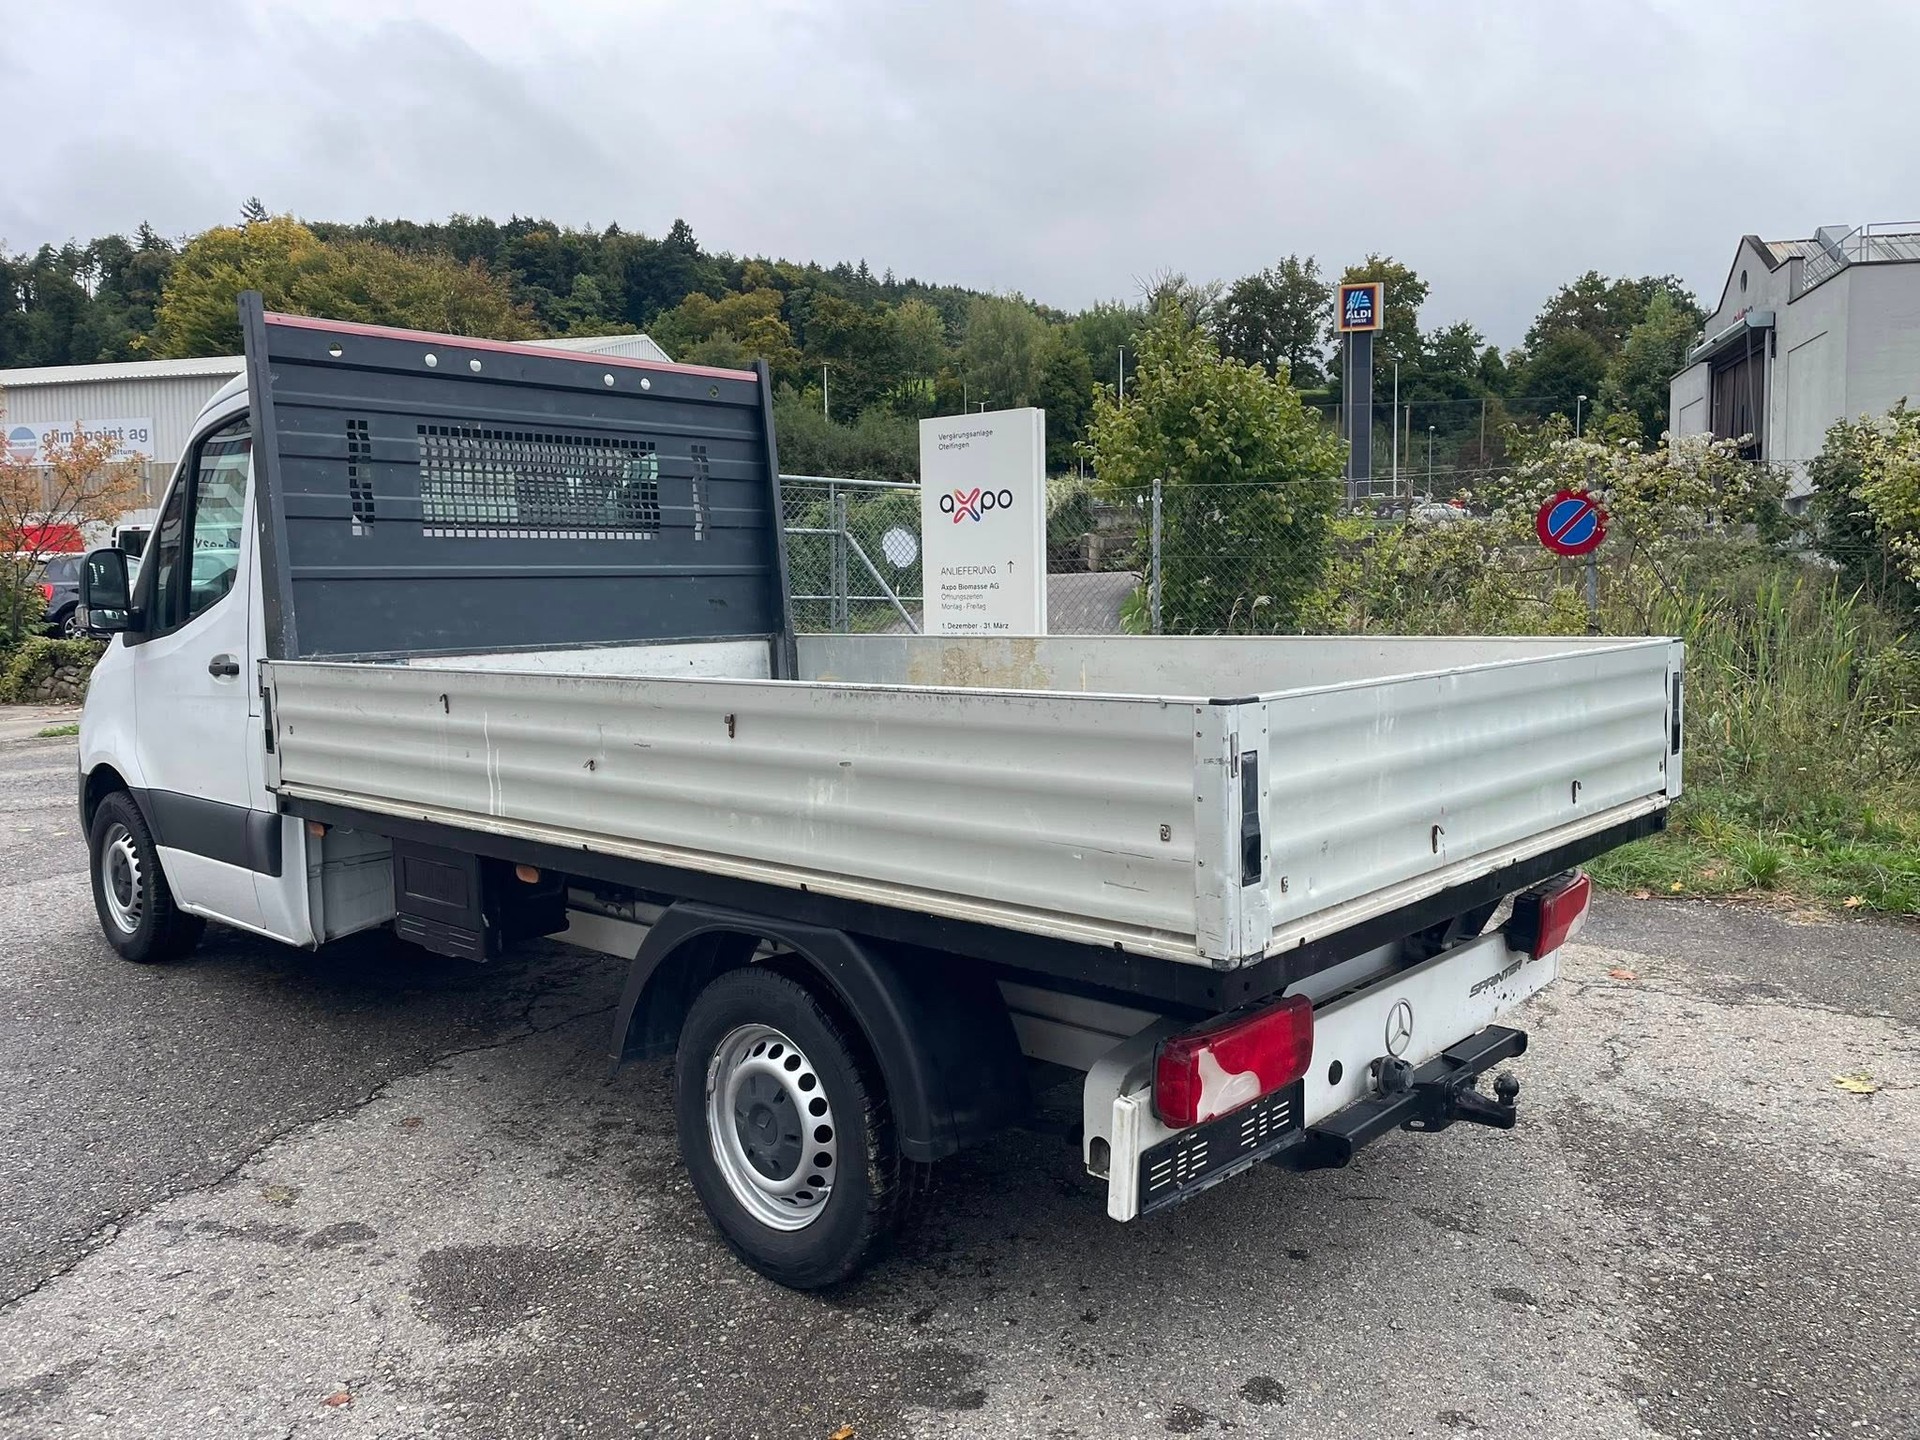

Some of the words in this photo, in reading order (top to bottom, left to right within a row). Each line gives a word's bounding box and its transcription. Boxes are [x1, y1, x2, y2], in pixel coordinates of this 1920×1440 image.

[1345, 309, 1372, 319] ALDI
[129, 428, 148, 442] ag
[940, 487, 1013, 524] axpo
[941, 565, 997, 576] ANLIEFERUNG
[941, 583, 957, 591] Axpo
[958, 583, 988, 591] Biomasse
[989, 582, 1000, 590] AG
[1469, 959, 1522, 998] SPRINTER
